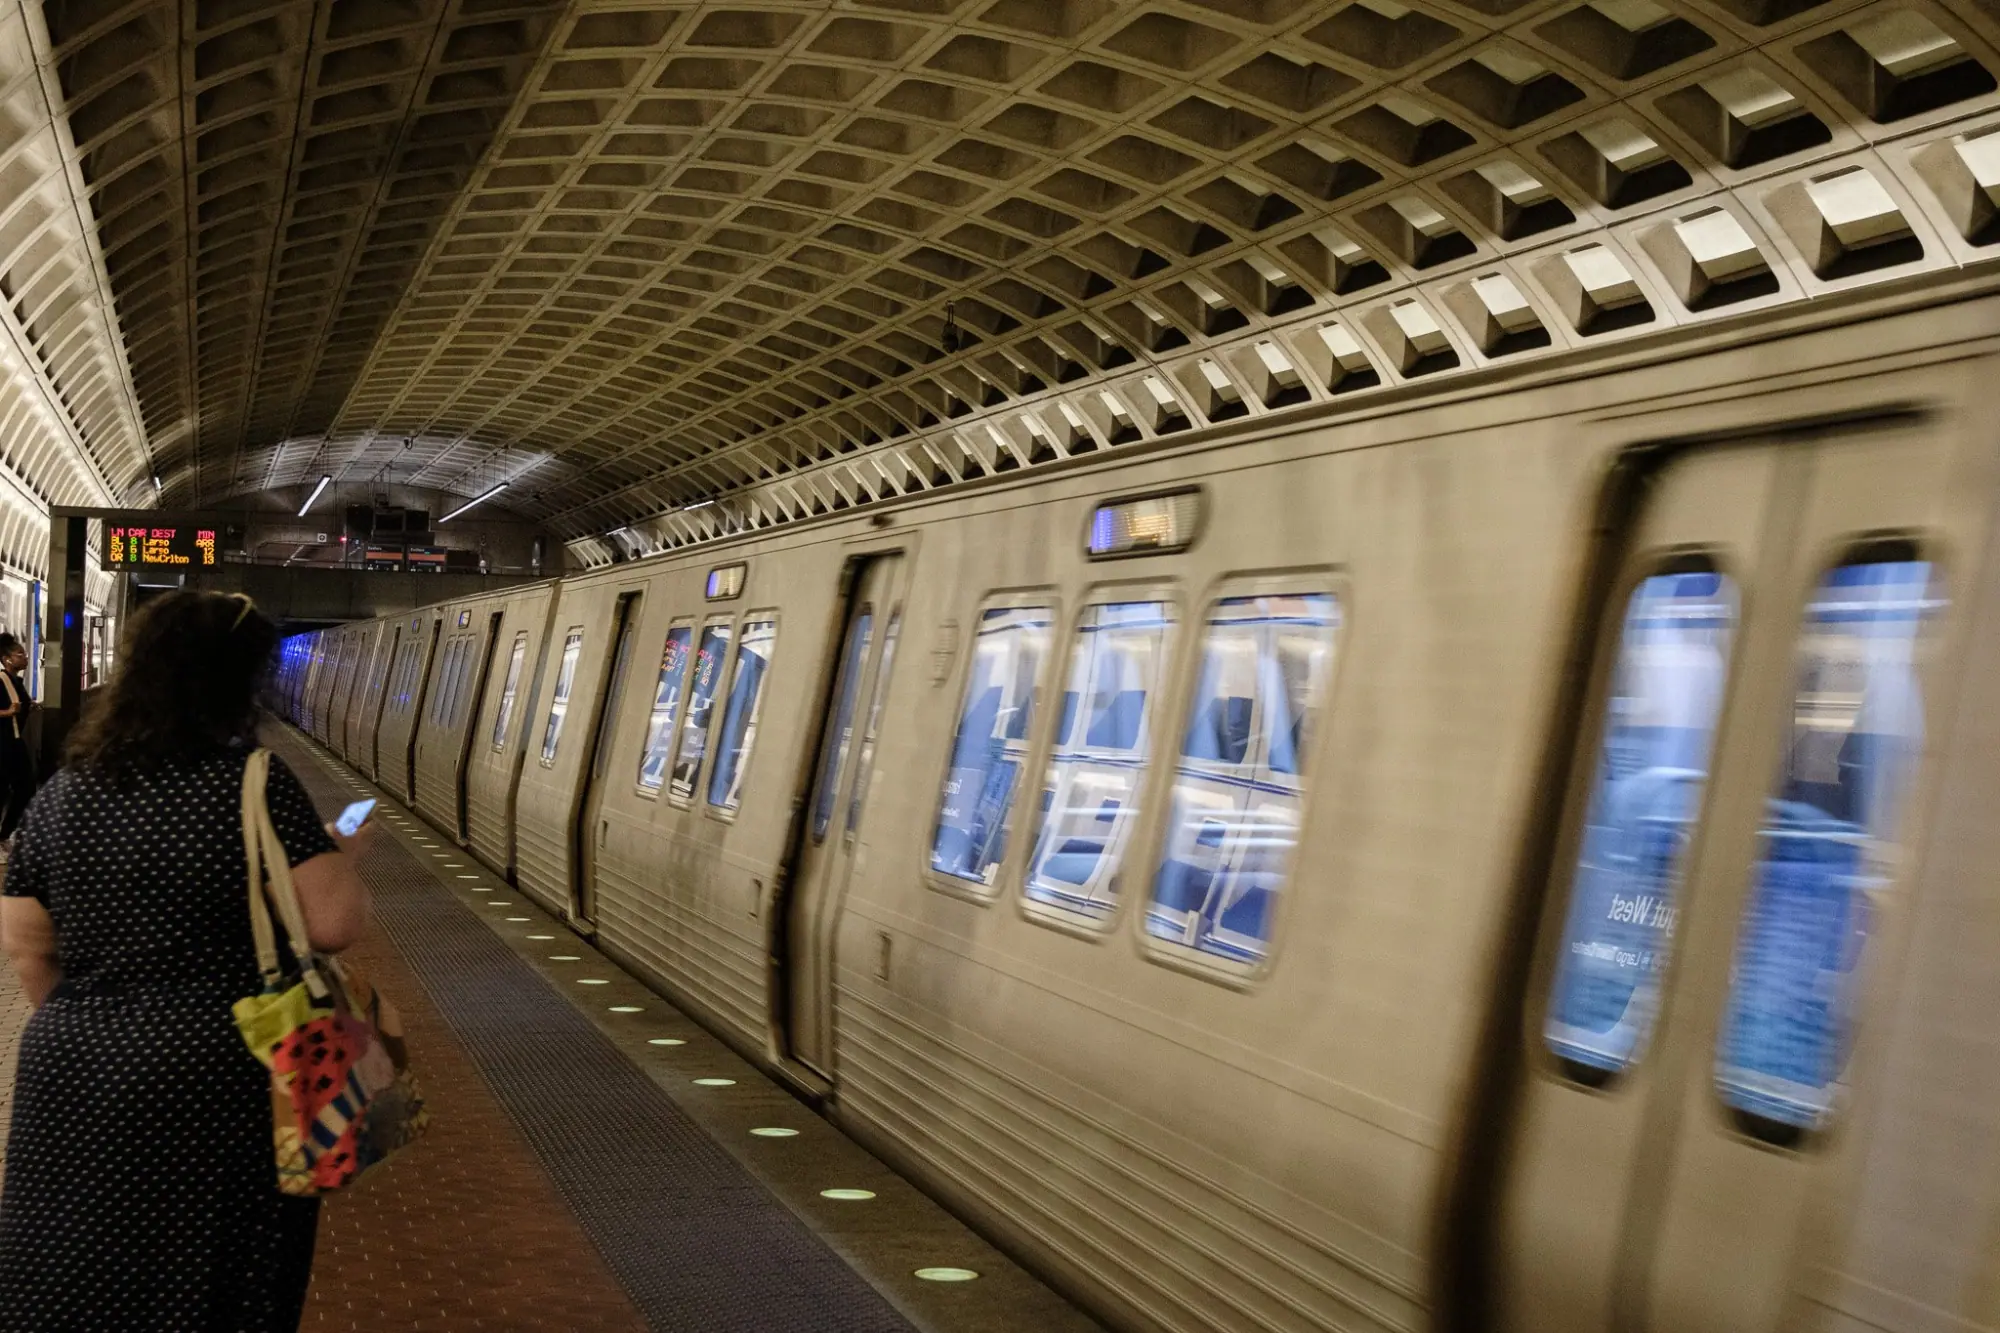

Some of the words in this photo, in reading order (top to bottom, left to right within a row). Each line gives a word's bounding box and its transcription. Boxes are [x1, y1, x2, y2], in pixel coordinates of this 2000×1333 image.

[110, 528, 124, 537] LN
[128, 528, 147, 537] CAR
[151, 528, 176, 539] DEST
[197, 530, 215, 539] MIN
[111, 536, 124, 545] BL
[131, 536, 137, 545] 8
[195, 539, 215, 548] ARR
[110, 545, 124, 553] SV
[130, 545, 137, 554] 6
[203, 547, 215, 556] 12
[110, 553, 124, 562] OR
[130, 554, 137, 562] 8
[203, 555, 215, 565] 13
